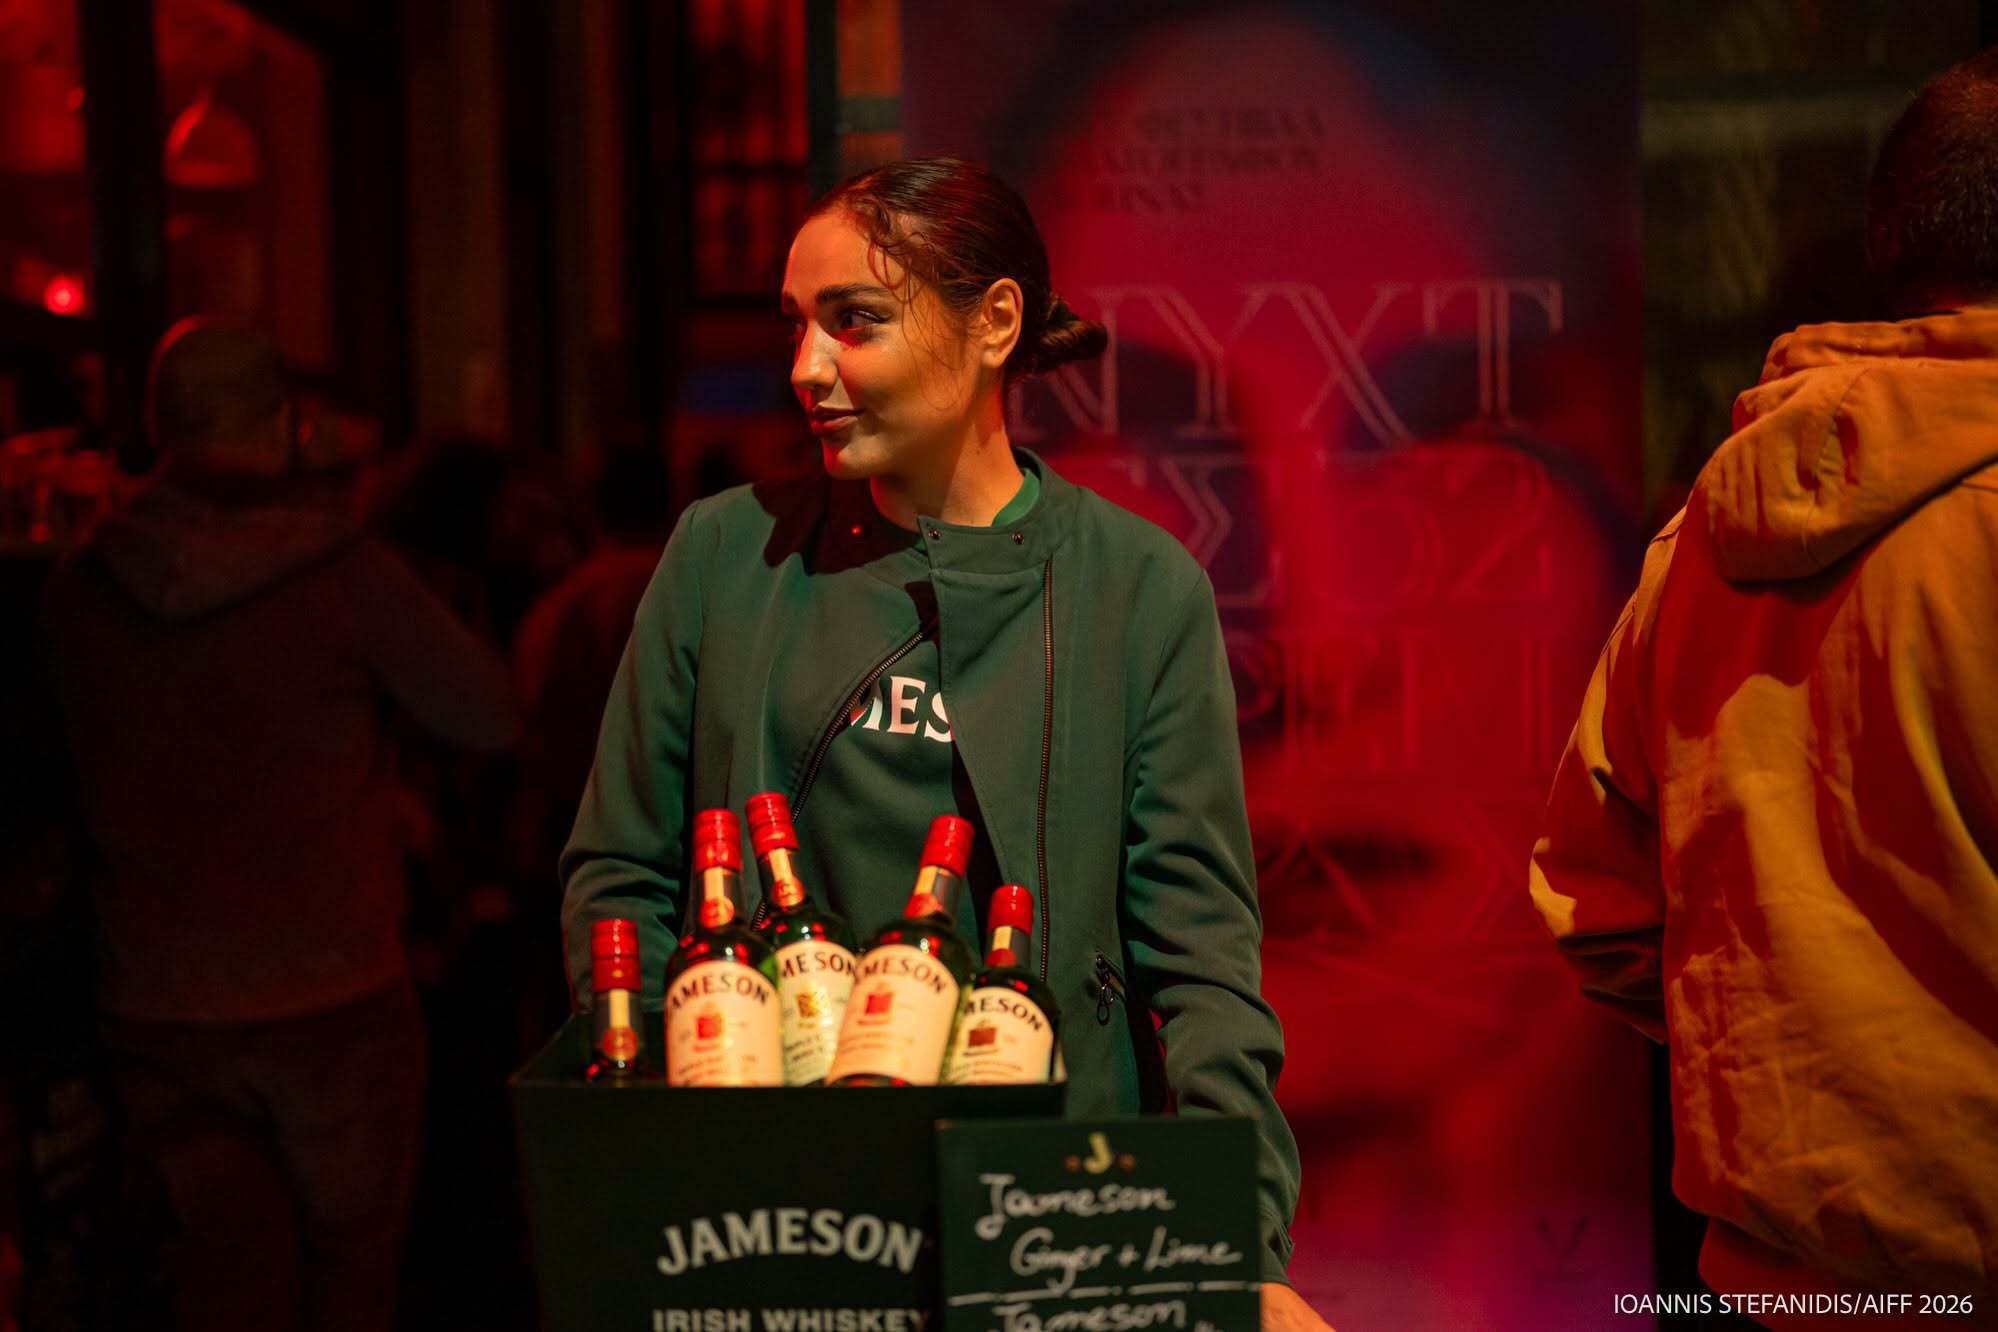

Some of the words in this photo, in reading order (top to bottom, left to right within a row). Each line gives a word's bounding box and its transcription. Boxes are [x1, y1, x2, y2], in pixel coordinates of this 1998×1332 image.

[667, 973, 769, 1010] AMESON
[853, 954, 946, 994] MESON
[975, 1172, 1176, 1241] Jameson
[656, 1206, 923, 1276] JAMESON
[1144, 1225, 1243, 1271] Lime
[652, 1308, 751, 1332] IRISH
[760, 1308, 931, 1332] WHISKEY
[988, 1300, 1187, 1332] Jameson
